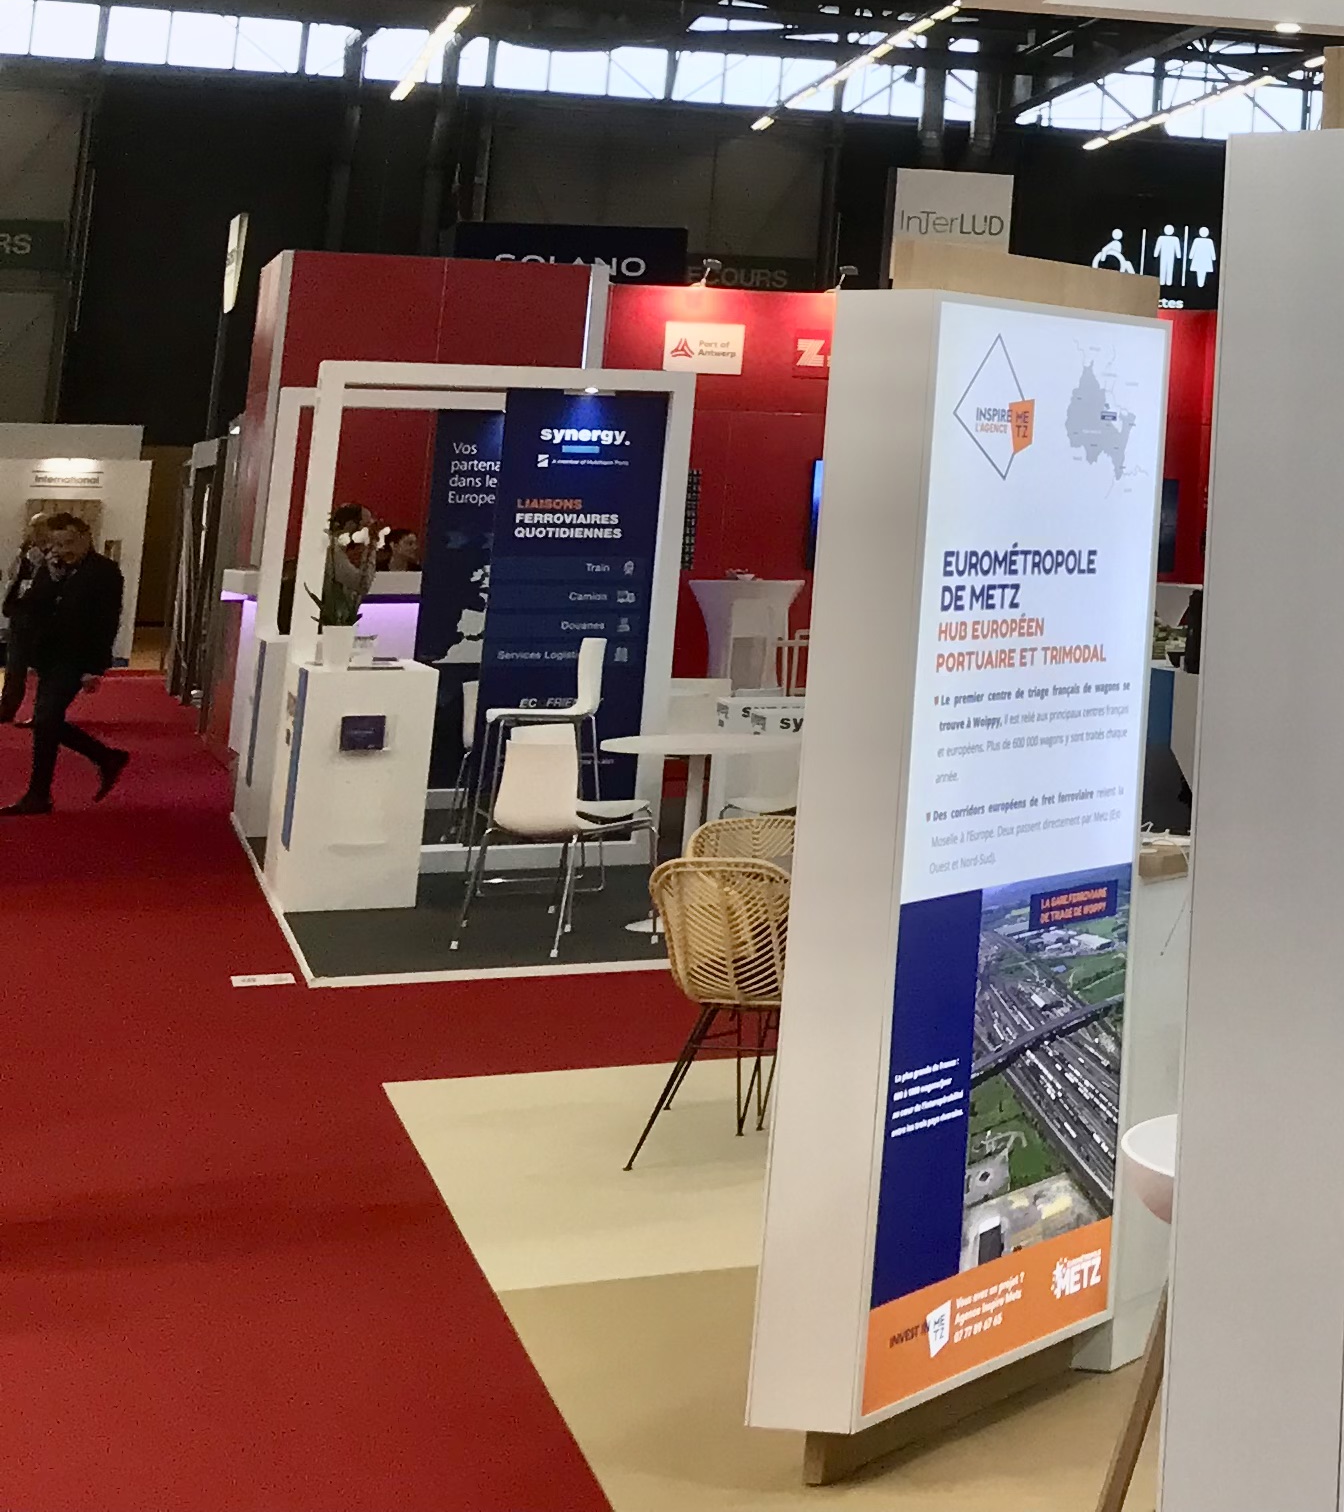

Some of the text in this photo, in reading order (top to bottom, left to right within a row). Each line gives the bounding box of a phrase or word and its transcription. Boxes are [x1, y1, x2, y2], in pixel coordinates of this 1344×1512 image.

[698, 349, 736, 359] Antwerp
[976, 407, 1012, 423] INSPIRE
[975, 423, 1008, 434] L'AGENCE
[452, 442, 477, 455] Vos
[449, 475, 482, 488] dans
[448, 491, 496, 507] Europe
[516, 499, 583, 510] LIAISONS
[515, 513, 619, 525] FERROVIAIRES
[514, 528, 623, 539] QUOTIDIENNES
[942, 542, 1098, 577] EUROMÉTROPOLE
[586, 563, 610, 572] Train
[569, 592, 608, 601] Camion
[940, 583, 1021, 612] DE METZ
[560, 621, 605, 630] Douanes
[938, 613, 1045, 642] HUB EUROPÉEN
[497, 651, 542, 660] Services
[936, 644, 1107, 673] PORTUAIRE ET TRIMODAL
[954, 692, 984, 708] premier
